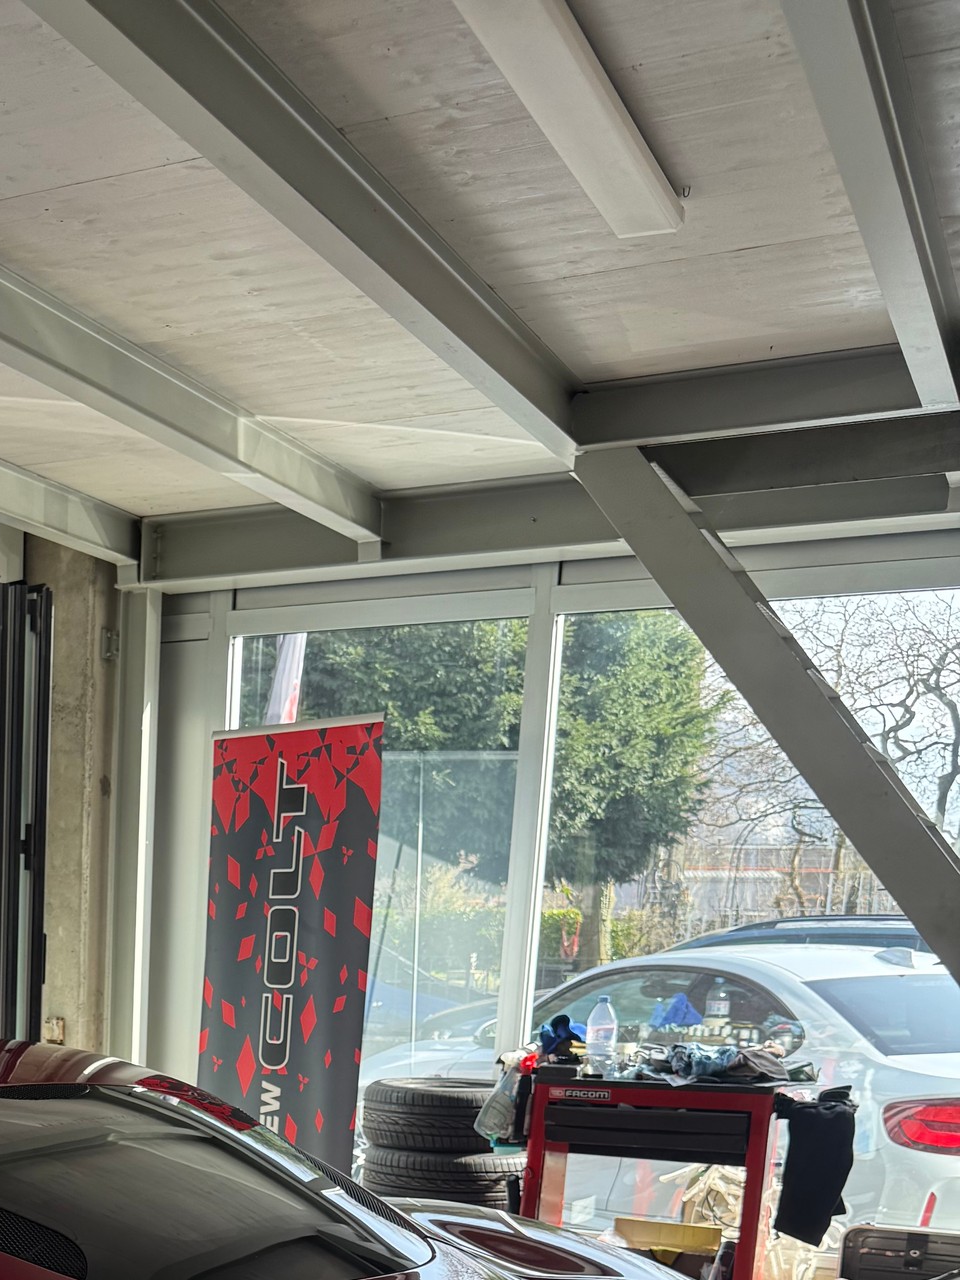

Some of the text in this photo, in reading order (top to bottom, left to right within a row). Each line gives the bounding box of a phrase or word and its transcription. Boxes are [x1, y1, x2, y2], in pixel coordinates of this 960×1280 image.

[258, 757, 308, 1133] EW COLT
[565, 1089, 609, 1100] FACOM
